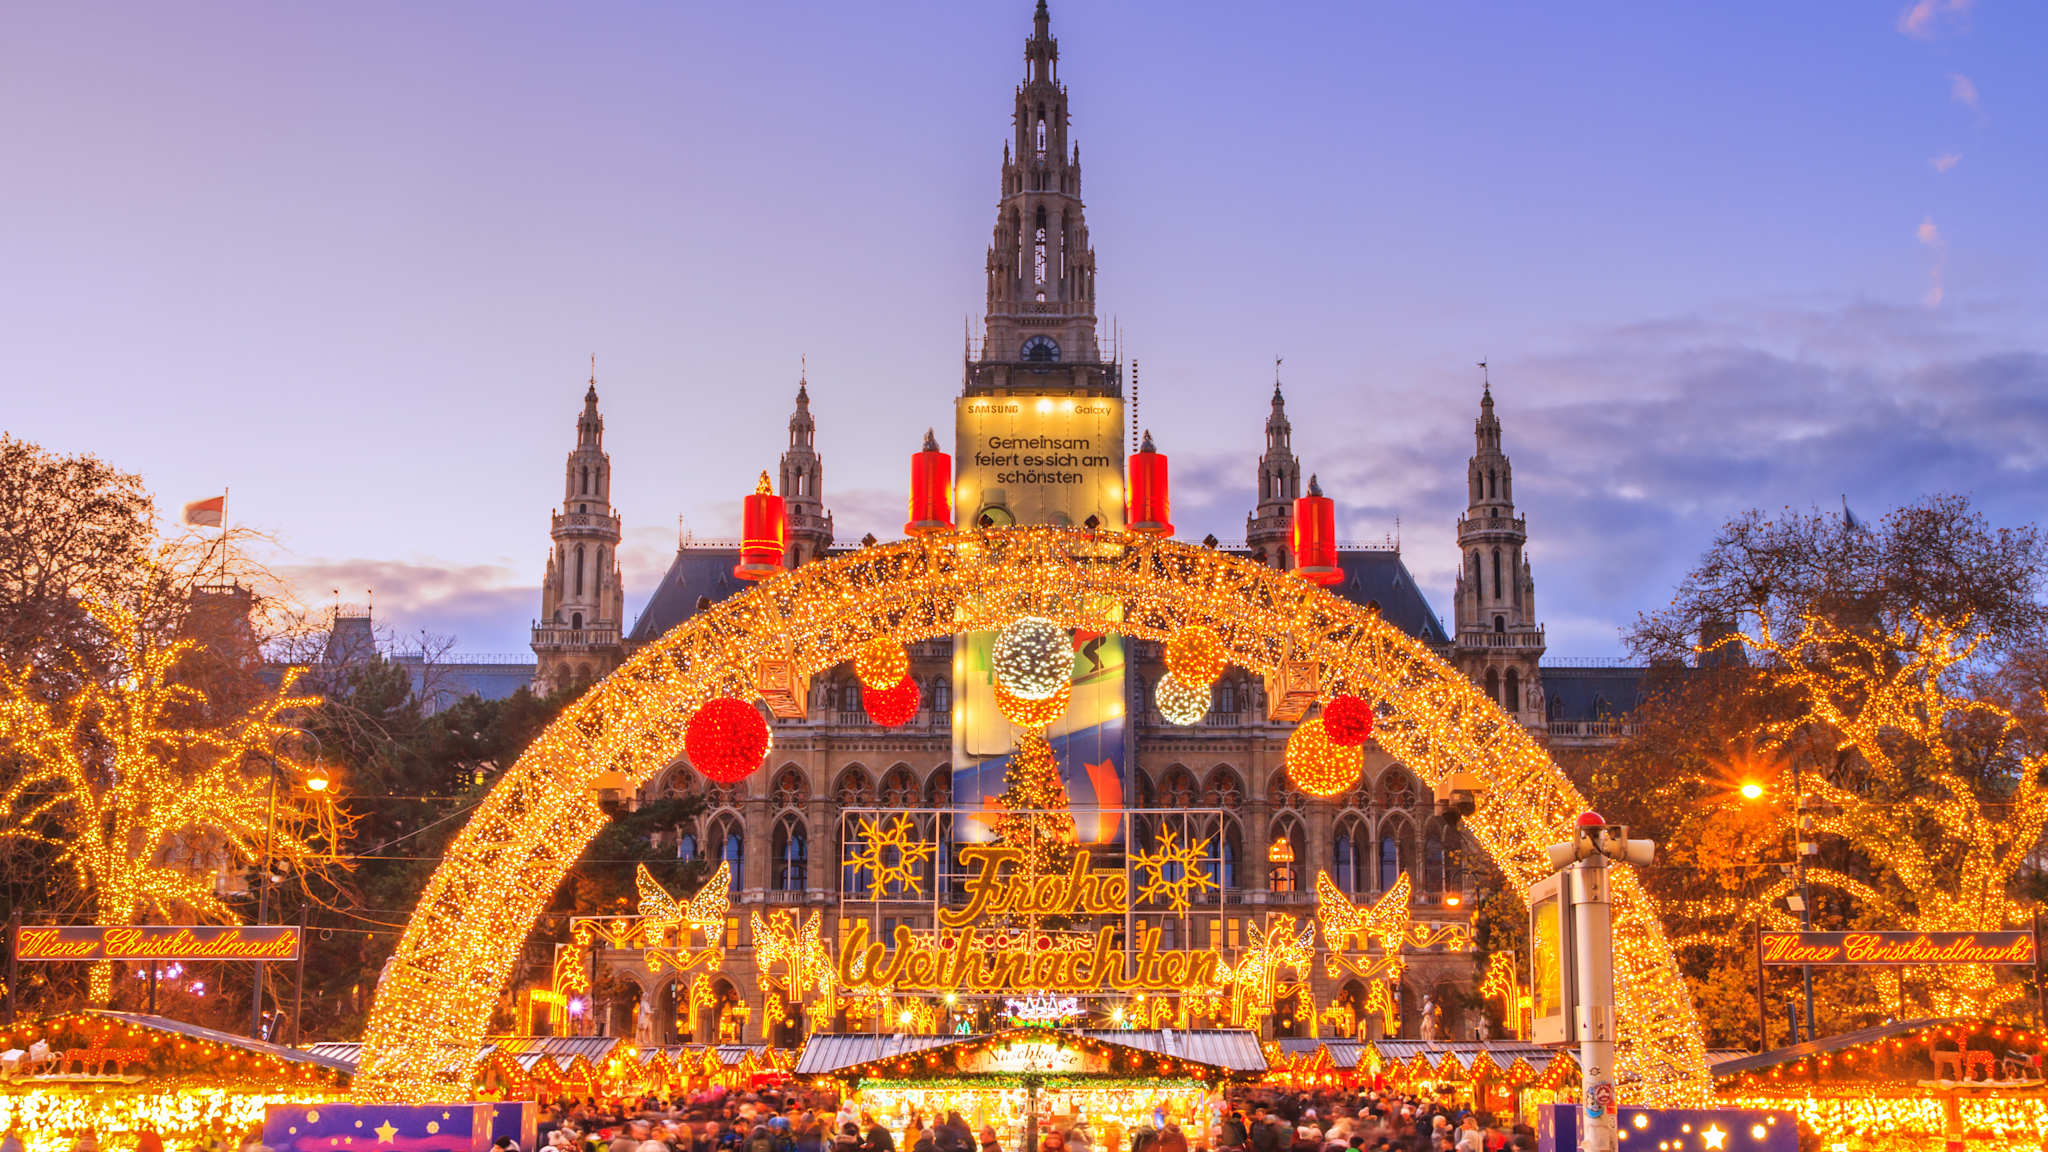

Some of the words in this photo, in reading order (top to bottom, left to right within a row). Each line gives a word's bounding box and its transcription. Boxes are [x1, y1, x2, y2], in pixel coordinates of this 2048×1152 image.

[968, 405, 1018, 414] SAMSUNG
[1074, 405, 1112, 416] Galaxy
[988, 435, 1090, 450] Gemeinsam
[974, 452, 1019, 467] feiert
[1023, 455, 1042, 467] es
[1043, 452, 1078, 467] sich
[1082, 455, 1110, 467] am
[997, 470, 1083, 484] schönsten
[938, 846, 1131, 926] Frohe
[19, 928, 98, 957] Wiener
[103, 928, 298, 957] Christkindlmarkt
[1763, 934, 1840, 961] Wiener
[1843, 934, 2033, 961] Christkindlmarkt
[839, 924, 1220, 990] Weihnachten
